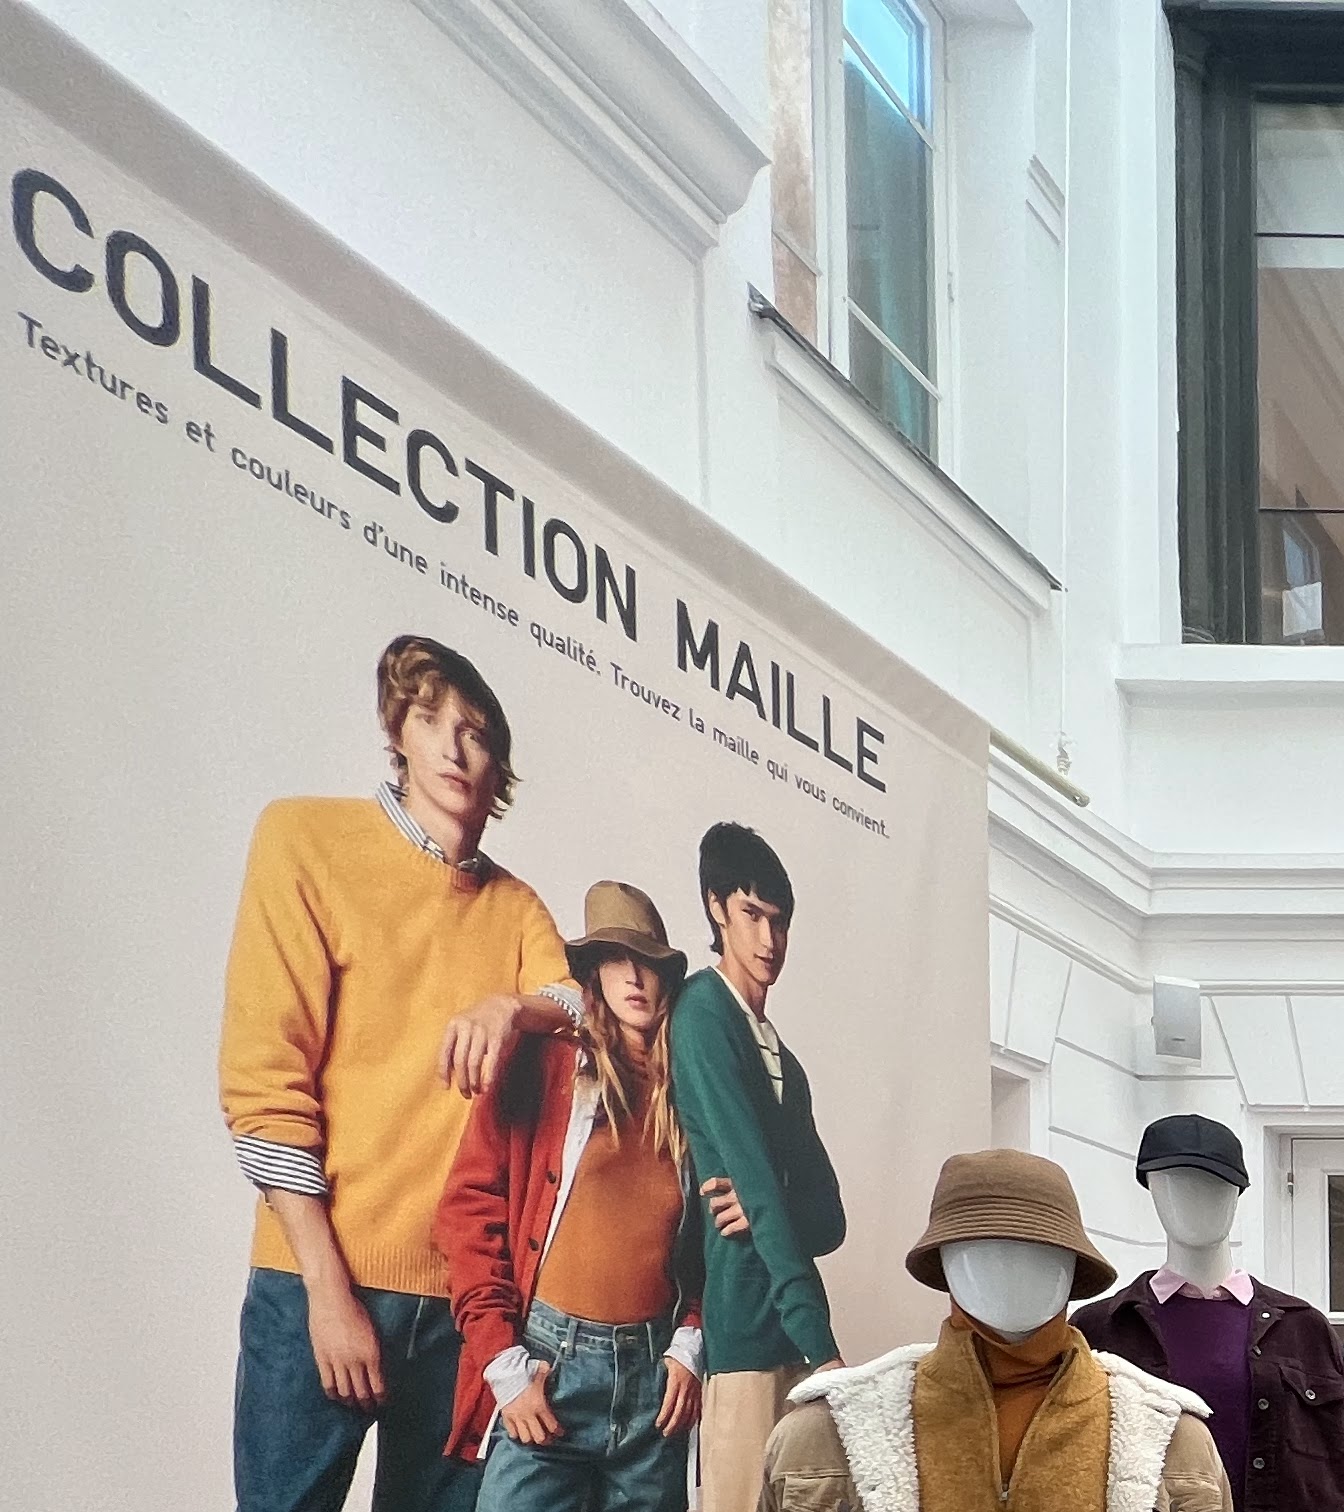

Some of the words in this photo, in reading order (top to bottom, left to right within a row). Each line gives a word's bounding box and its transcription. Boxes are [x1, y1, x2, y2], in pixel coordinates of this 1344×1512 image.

[10, 168, 638, 642] COLLECTION
[676, 598, 887, 793] MAILLE
[17, 311, 169, 424] Textures
[186, 419, 216, 453] et
[231, 446, 351, 529] couleurs
[363, 521, 428, 574] d'une
[439, 561, 519, 628] intense
[530, 620, 602, 676] qualité.
[610, 662, 681, 721] Trouvez
[688, 708, 705, 734] la
[712, 726, 759, 766] maille
[766, 759, 788, 783] qui
[795, 776, 826, 803] vous
[832, 795, 890, 839] convient.
